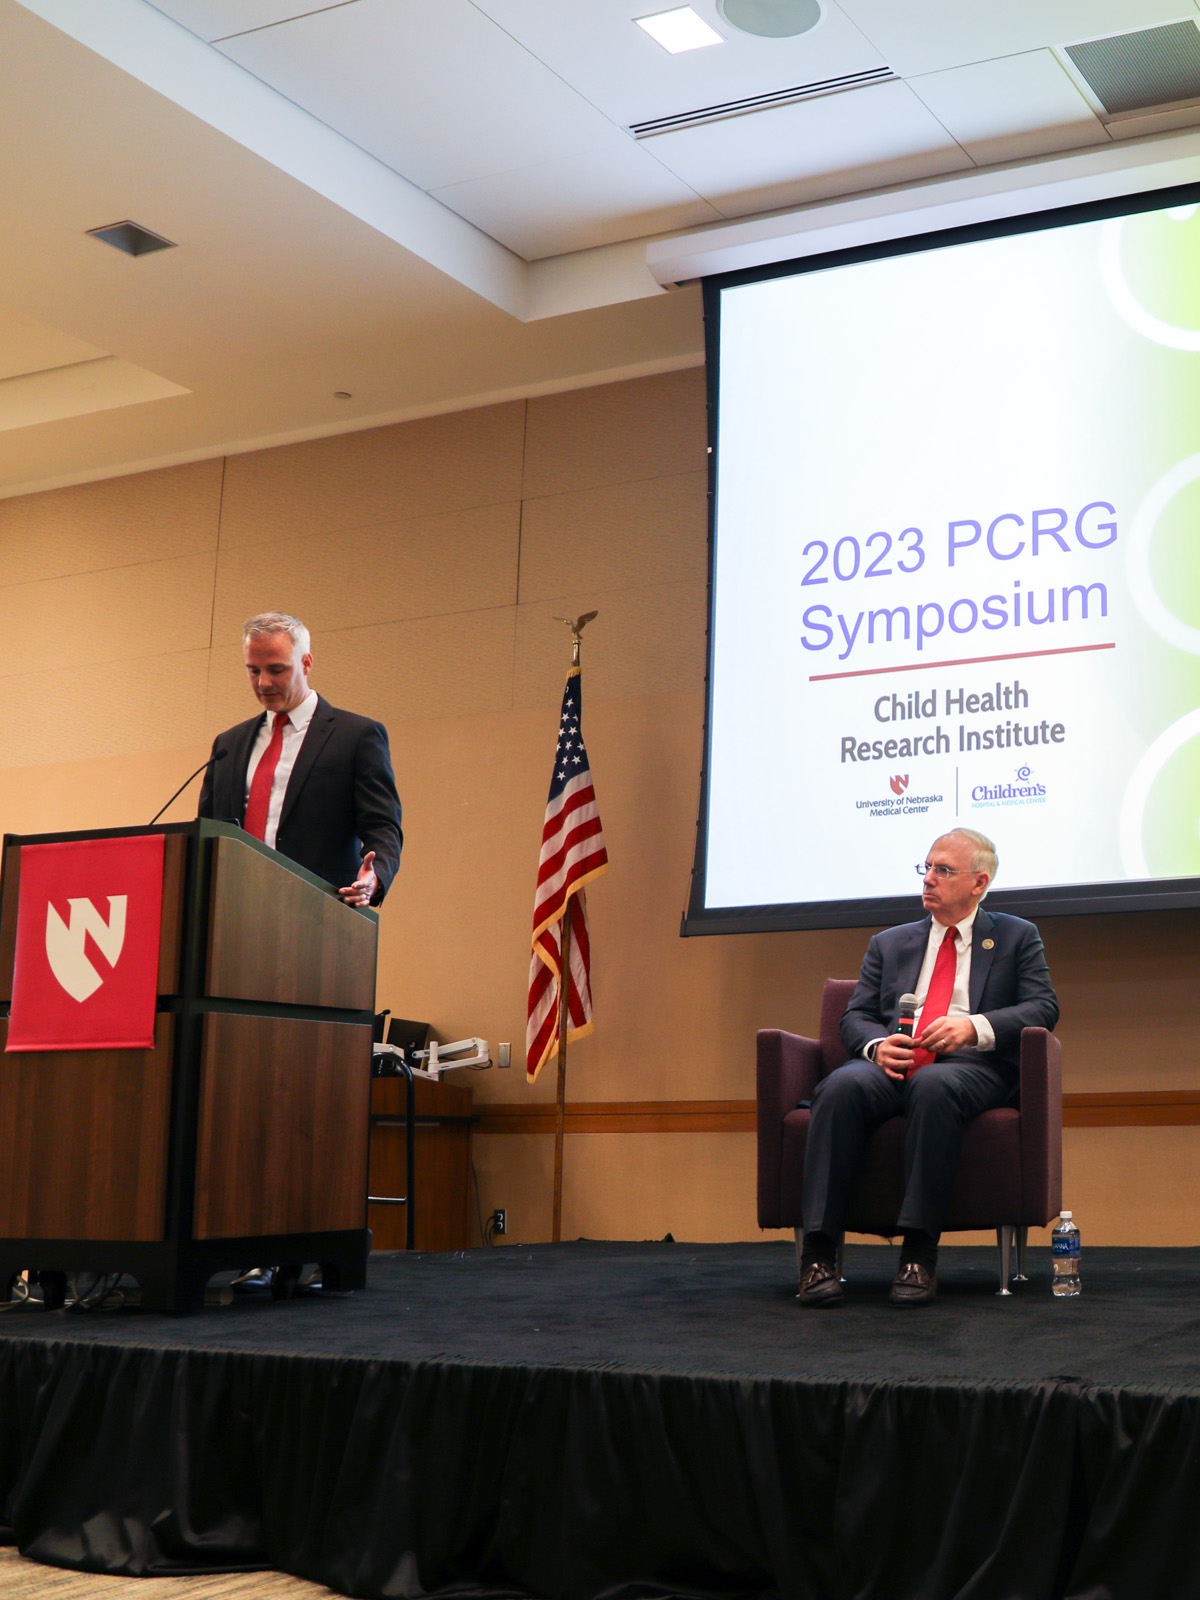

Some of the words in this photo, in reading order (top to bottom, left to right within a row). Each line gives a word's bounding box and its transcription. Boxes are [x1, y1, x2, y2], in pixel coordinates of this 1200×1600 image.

[801, 527, 926, 587] 2023
[948, 501, 1118, 567] PCRG
[800, 580, 1108, 660] Symposium
[874, 689, 937, 722] Child
[945, 680, 1029, 716] Health
[841, 726, 950, 763] Research
[959, 720, 1066, 752] Institute
[856, 798, 895, 809] University
[896, 797, 905, 805] of
[906, 794, 943, 804] Nebraska
[870, 806, 902, 817] Medical
[902, 805, 929, 814] Center
[972, 783, 1046, 801] Children's
